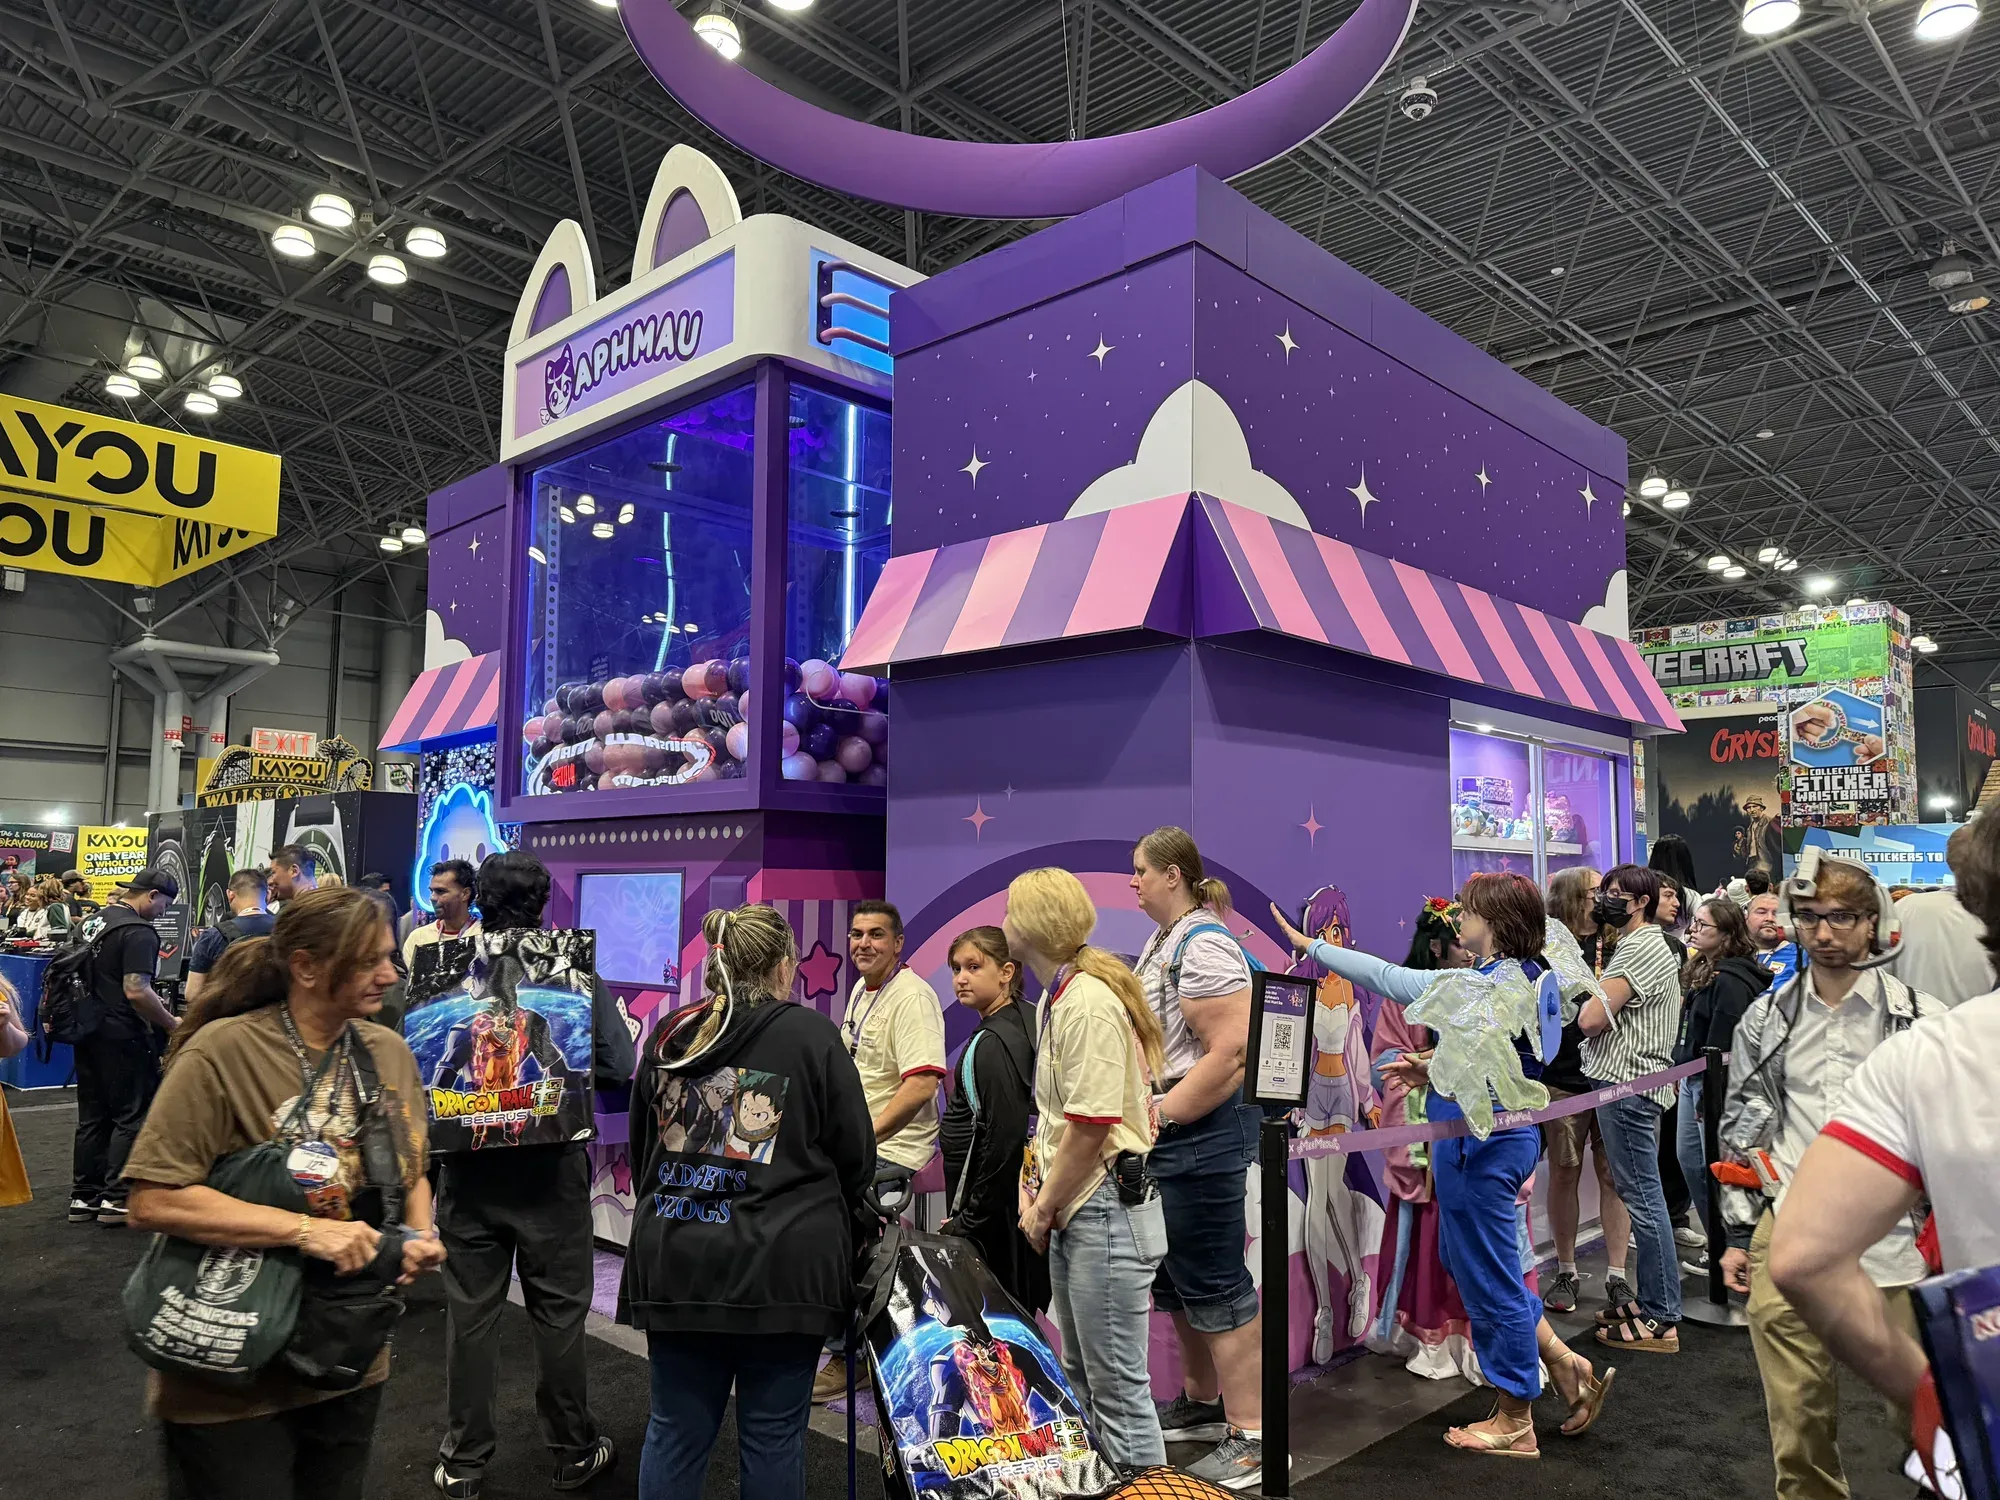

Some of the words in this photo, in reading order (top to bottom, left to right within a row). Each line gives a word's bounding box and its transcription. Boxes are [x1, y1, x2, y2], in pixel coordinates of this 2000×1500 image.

[573, 311, 702, 398] APHMAU
[255, 730, 313, 755] EXIT
[258, 759, 322, 779] KAYOU
[1809, 766, 1871, 776] COLLECTIBLE
[1796, 773, 1887, 792] STICKER
[204, 787, 263, 808] WALLS
[1795, 789, 1888, 802] WRISTBANDS
[22, 831, 48, 839] FOLLOW
[87, 834, 147, 848] KAYOU
[84, 852, 111, 862] ONE
[1864, 852, 1924, 863] STICKERS
[1925, 852, 1944, 863] TO
[431, 1088, 501, 1118] DRAGON
[500, 1083, 535, 1112] BALL
[462, 1111, 527, 1126] BEERUS
[532, 1106, 556, 1116] SUPER
[658, 1161, 748, 1192] GADGET'S
[934, 1433, 1024, 1478] DRAGON
[1019, 1424, 1061, 1458] BALL
[987, 1457, 1061, 1479] BEERUS
